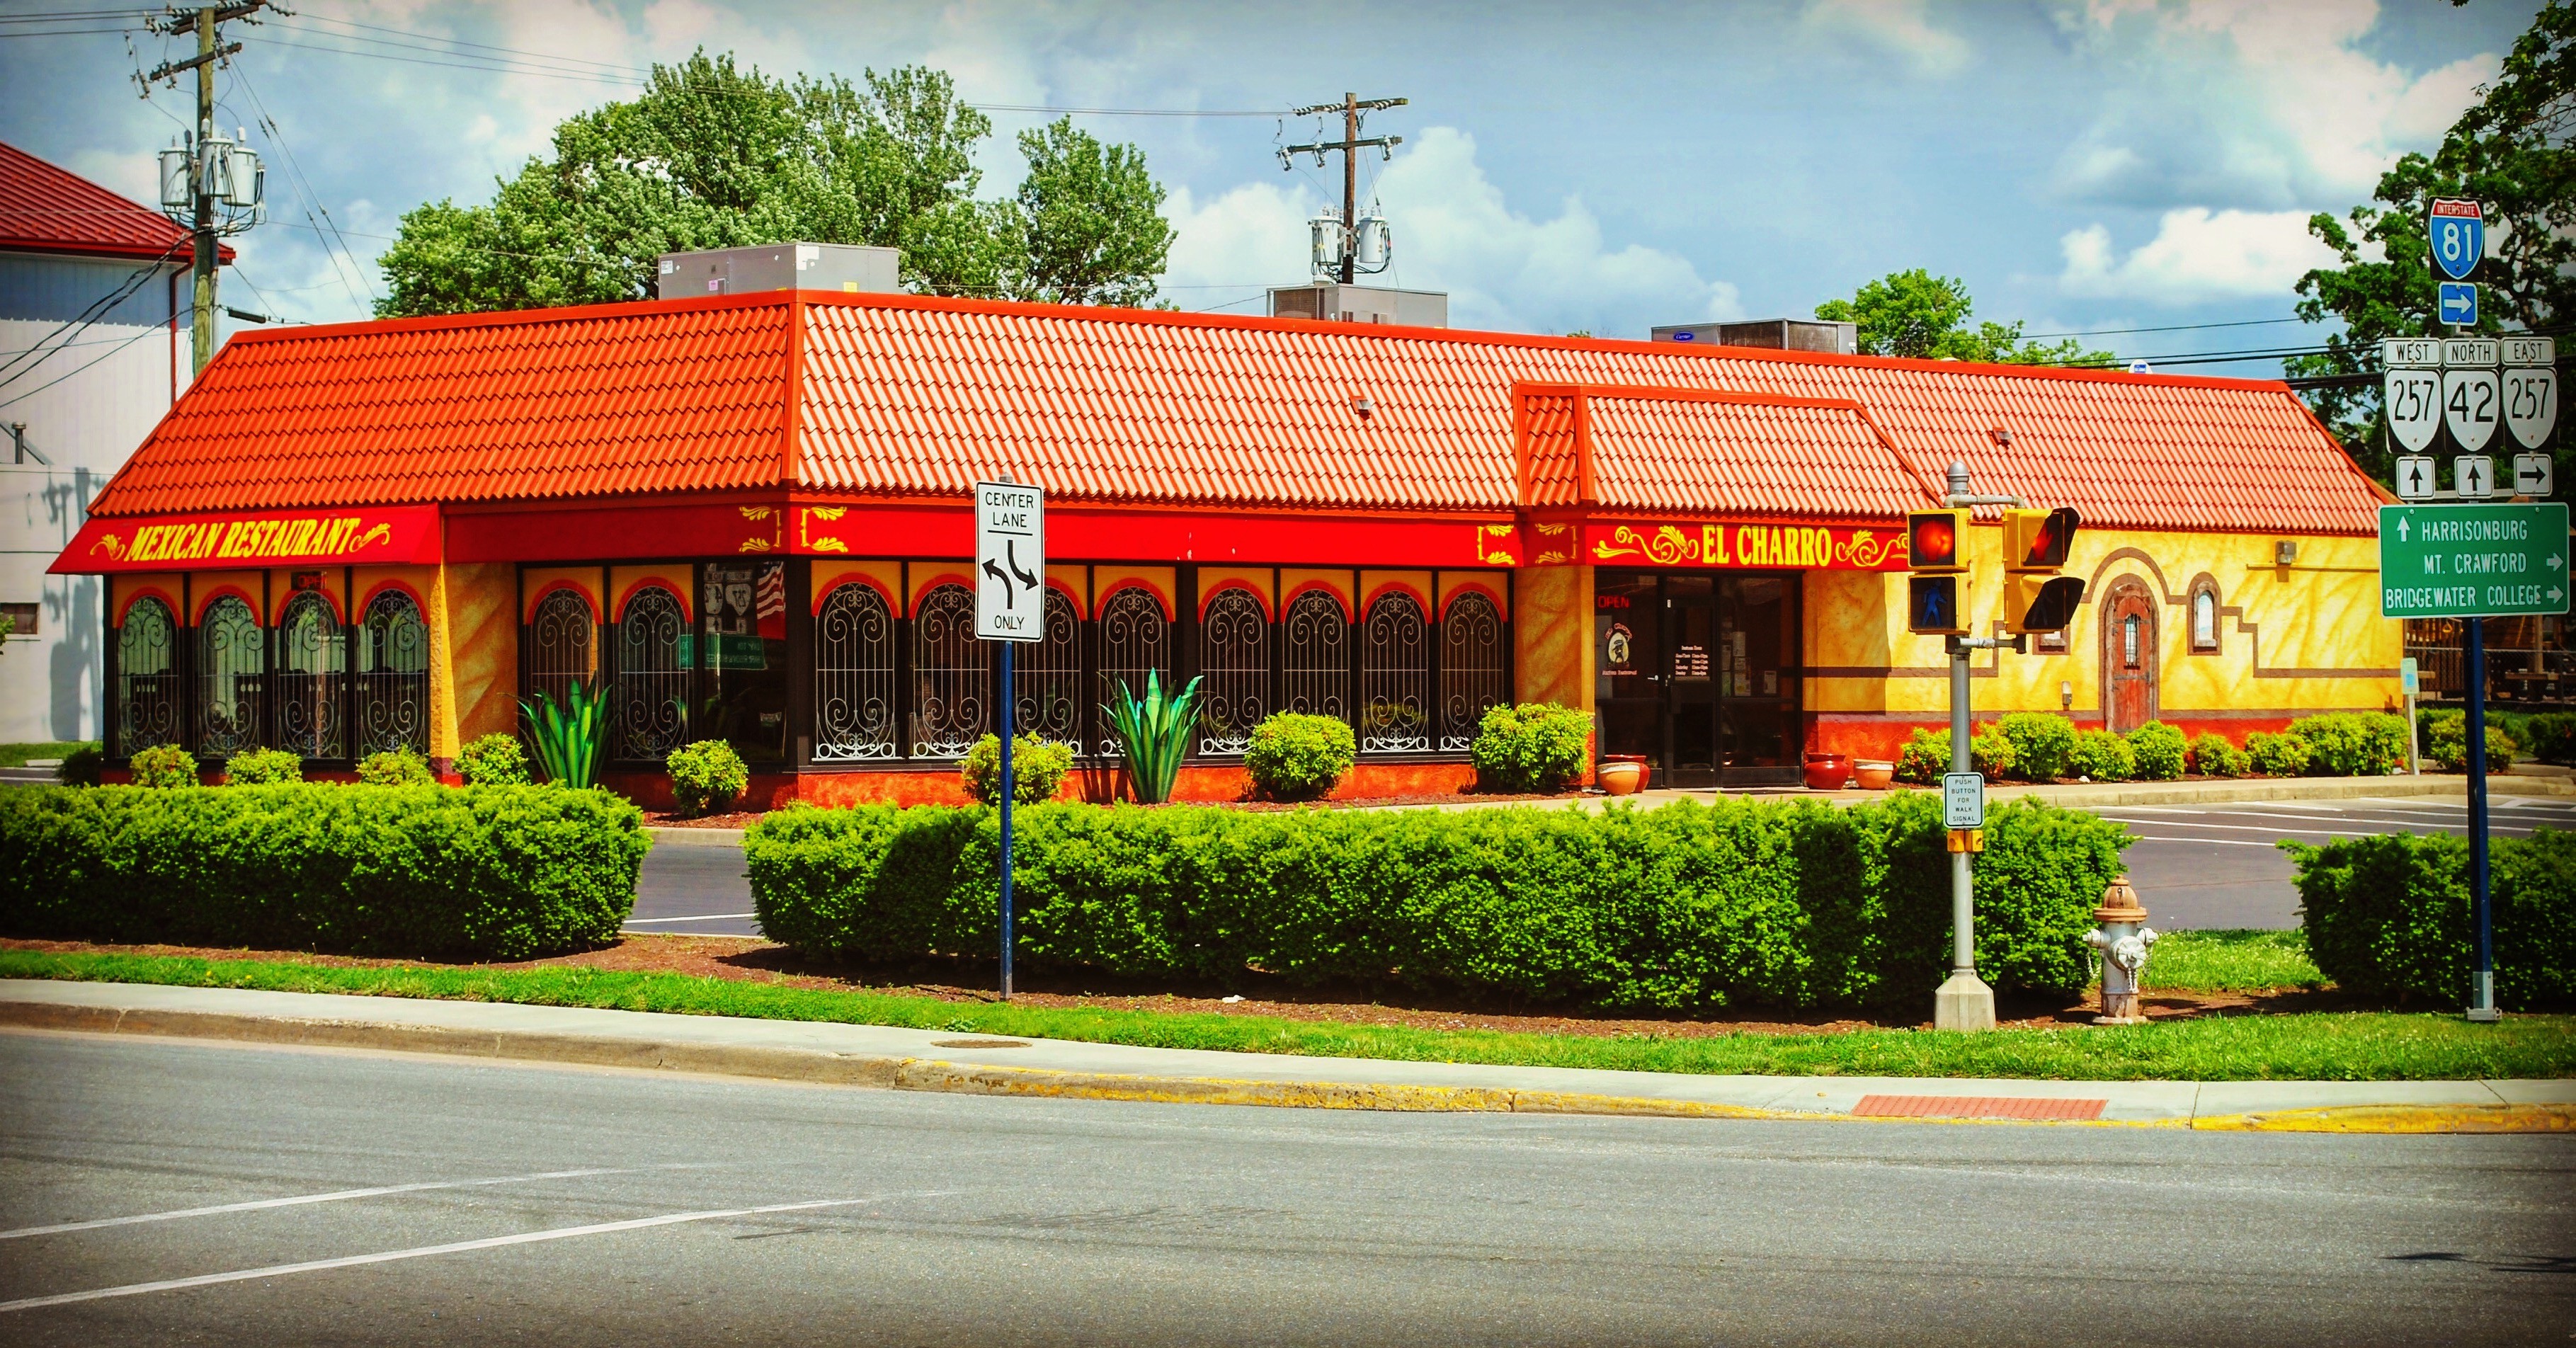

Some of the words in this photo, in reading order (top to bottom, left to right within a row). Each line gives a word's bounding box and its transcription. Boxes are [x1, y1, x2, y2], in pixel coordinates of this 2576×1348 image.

[2437, 204, 2475, 217] INTERSTATE
[2443, 222, 2472, 261] 81
[2396, 343, 2429, 362] WEST
[2451, 343, 2491, 362] NORTH
[2514, 343, 2543, 360] EAST
[2393, 379, 2434, 422] 257
[2449, 381, 2493, 423] 42
[2509, 378, 2550, 420] 257
[985, 491, 1034, 508] CENTER
[993, 512, 1027, 527] LANE
[124, 523, 224, 561] MEXICAN
[216, 518, 361, 558] RESTAURANT
[2422, 520, 2528, 542] HARRISONBURG
[1702, 525, 1730, 564] EL
[1736, 525, 1833, 566] CHARRO
[2424, 554, 2446, 574] MT.
[2455, 553, 2526, 574] CRAWFORD
[1598, 595, 1630, 608] OPEN
[2386, 587, 2476, 609] BRIDGEWATER
[2487, 585, 2541, 606] COLLEGE
[994, 615, 1025, 630] ONLY
